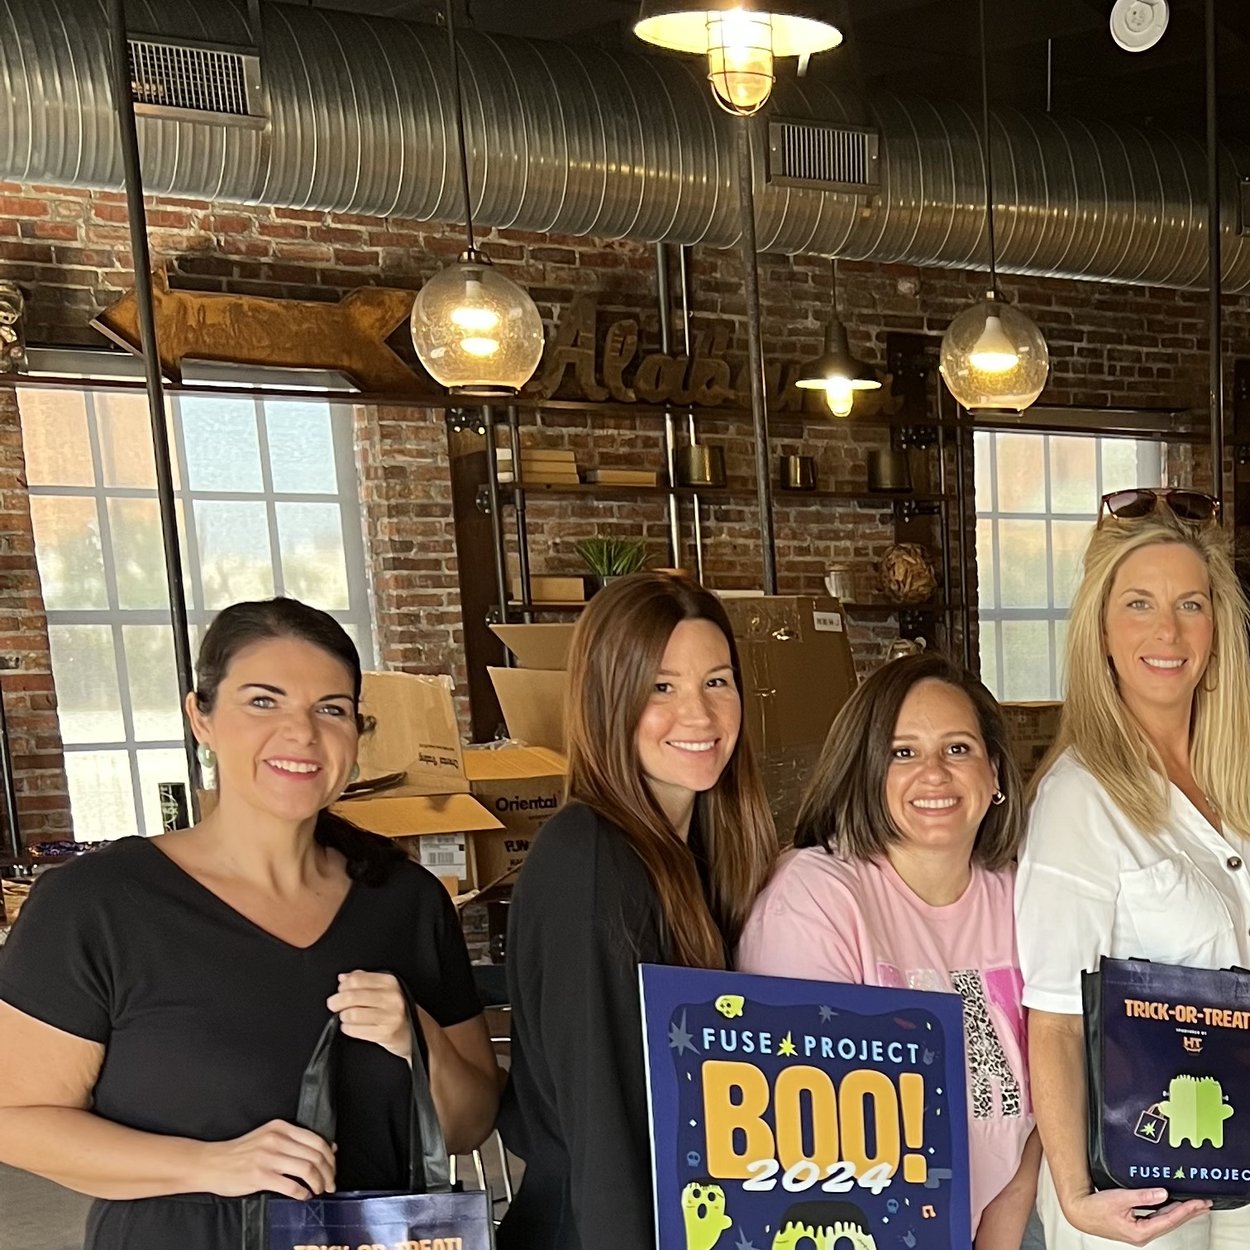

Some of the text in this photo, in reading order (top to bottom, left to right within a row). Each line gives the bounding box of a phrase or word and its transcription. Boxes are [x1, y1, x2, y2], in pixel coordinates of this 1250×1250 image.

[524, 298, 906, 413] Alab
[495, 795, 558, 812] Oriental
[702, 1027, 919, 1064] FUSE PROJECT
[701, 1060, 928, 1184] BOO!
[742, 1158, 893, 1195] 2024
[1129, 1166, 1171, 1179] FUSE
